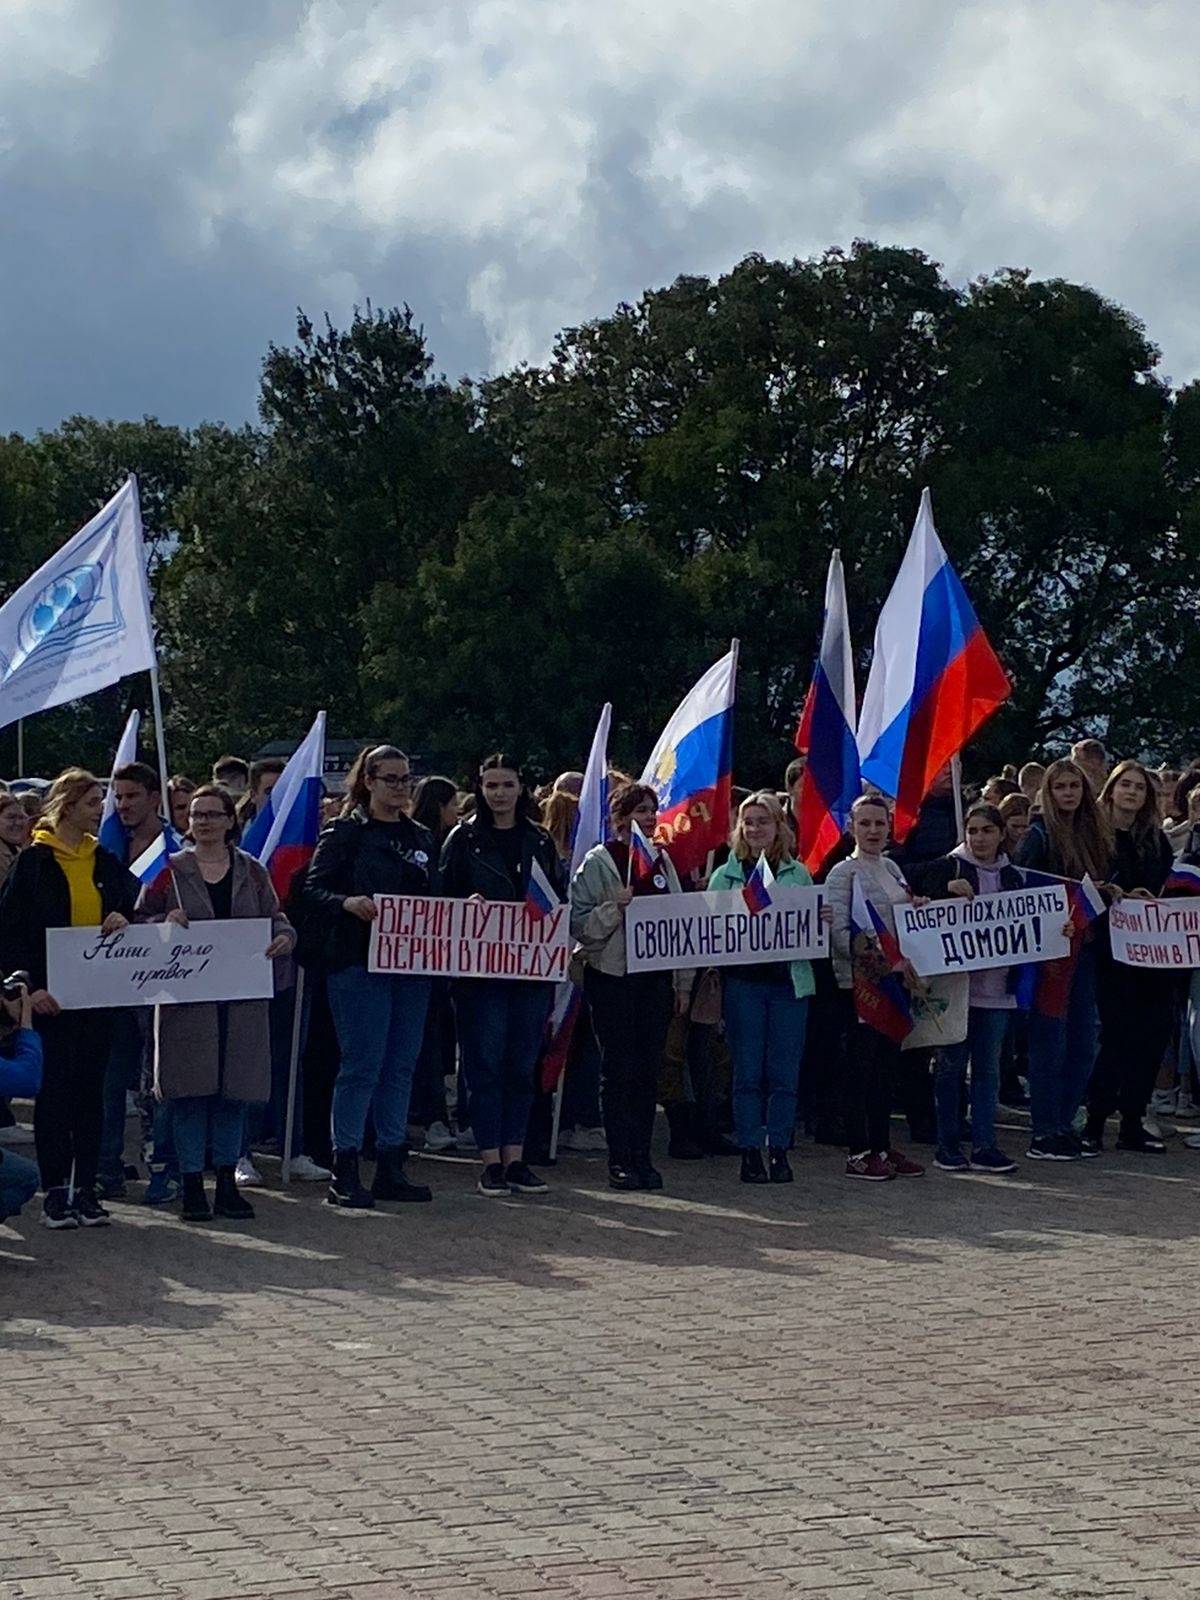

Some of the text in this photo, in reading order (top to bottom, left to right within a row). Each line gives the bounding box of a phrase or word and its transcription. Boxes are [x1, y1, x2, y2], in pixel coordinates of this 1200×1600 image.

[378, 897, 454, 937] ВЕРИМ
[904, 892, 1064, 933] ДОБРО ПОЖАЛОВАТЬ
[83, 932, 152, 960] Наше
[376, 935, 566, 978] ВЕРИМ В ПОБЕДУ!
[634, 916, 696, 959] СВОИХ
[699, 915, 722, 954] НЕ
[940, 916, 1042, 966] ДОМОЙ!
[1171, 944, 1183, 964] В
